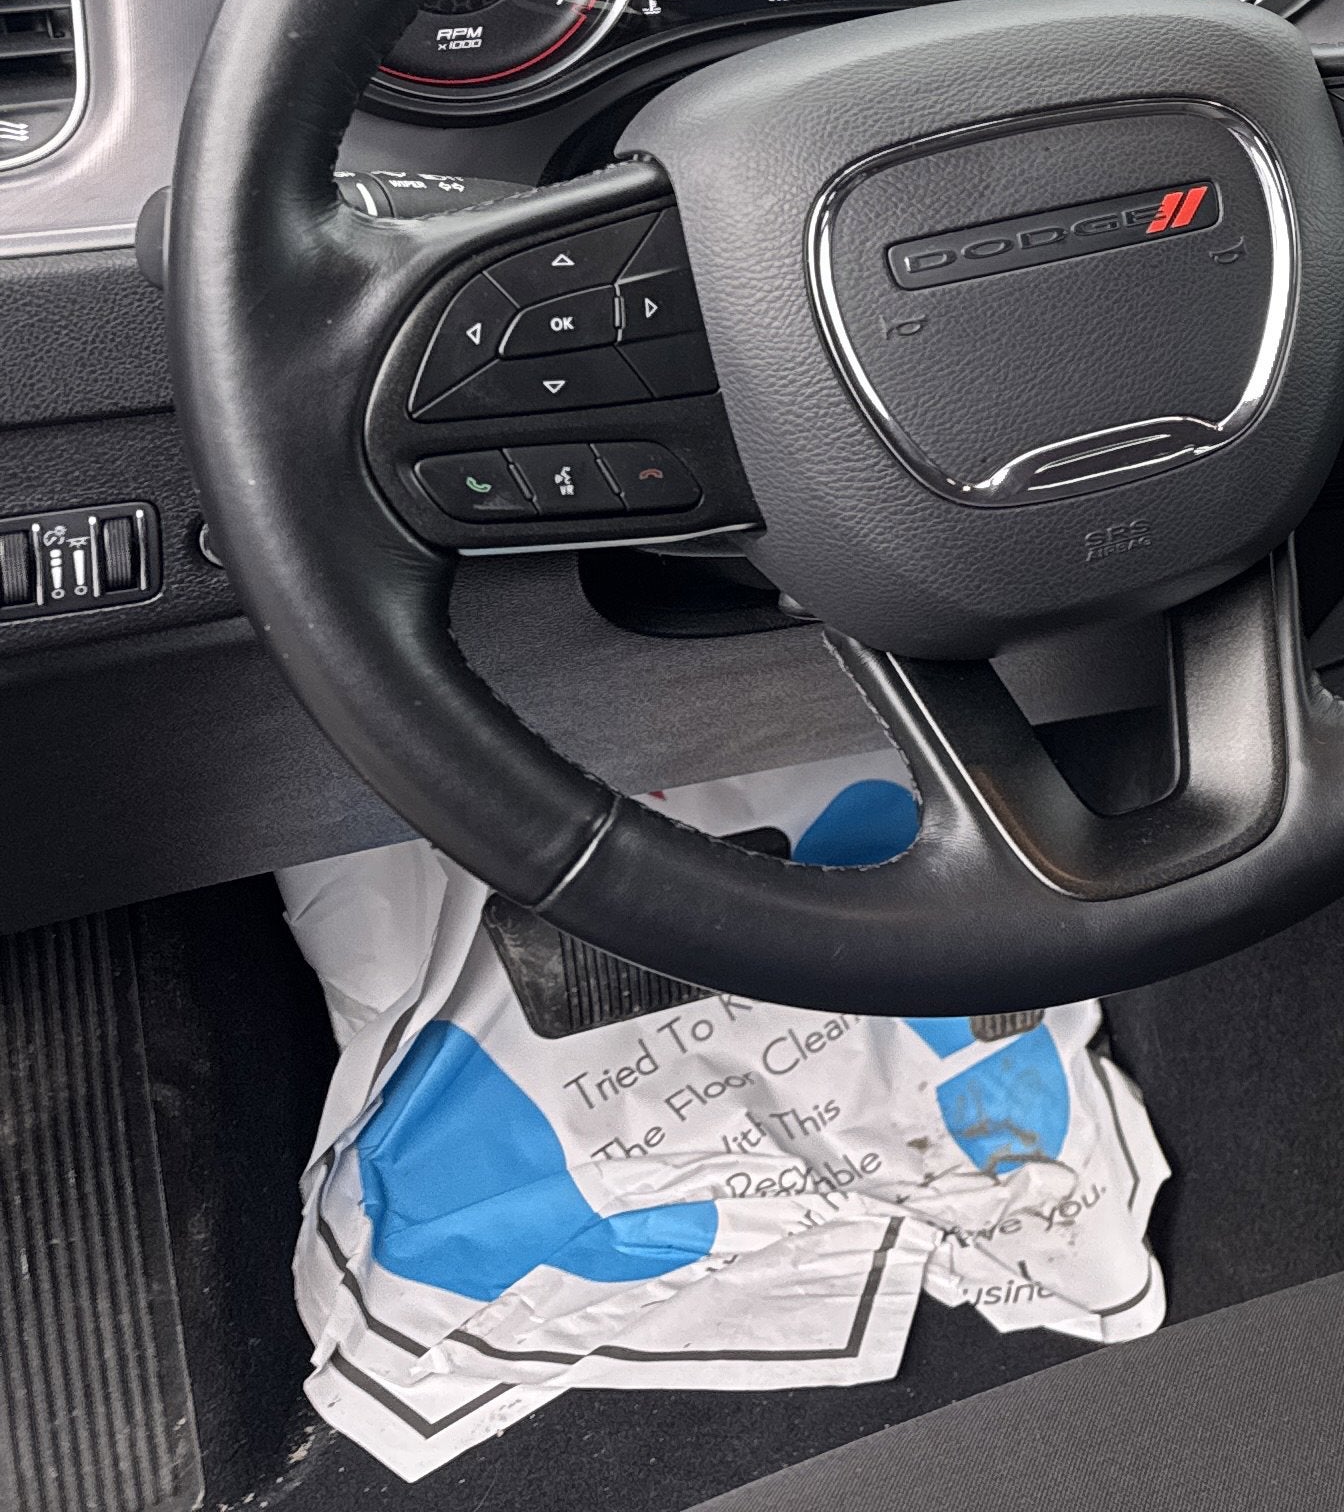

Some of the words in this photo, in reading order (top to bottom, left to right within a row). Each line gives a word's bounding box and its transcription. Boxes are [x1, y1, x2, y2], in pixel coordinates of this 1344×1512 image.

[437, 27, 483, 41] RPM
[904, 202, 1167, 273] DODGE
[550, 316, 575, 332] OK
[563, 1038, 659, 1110] Tried
[657, 1016, 714, 1053] To
[590, 1125, 666, 1161] The
[664, 1068, 756, 1122] Floor
[769, 1099, 841, 1139] This
